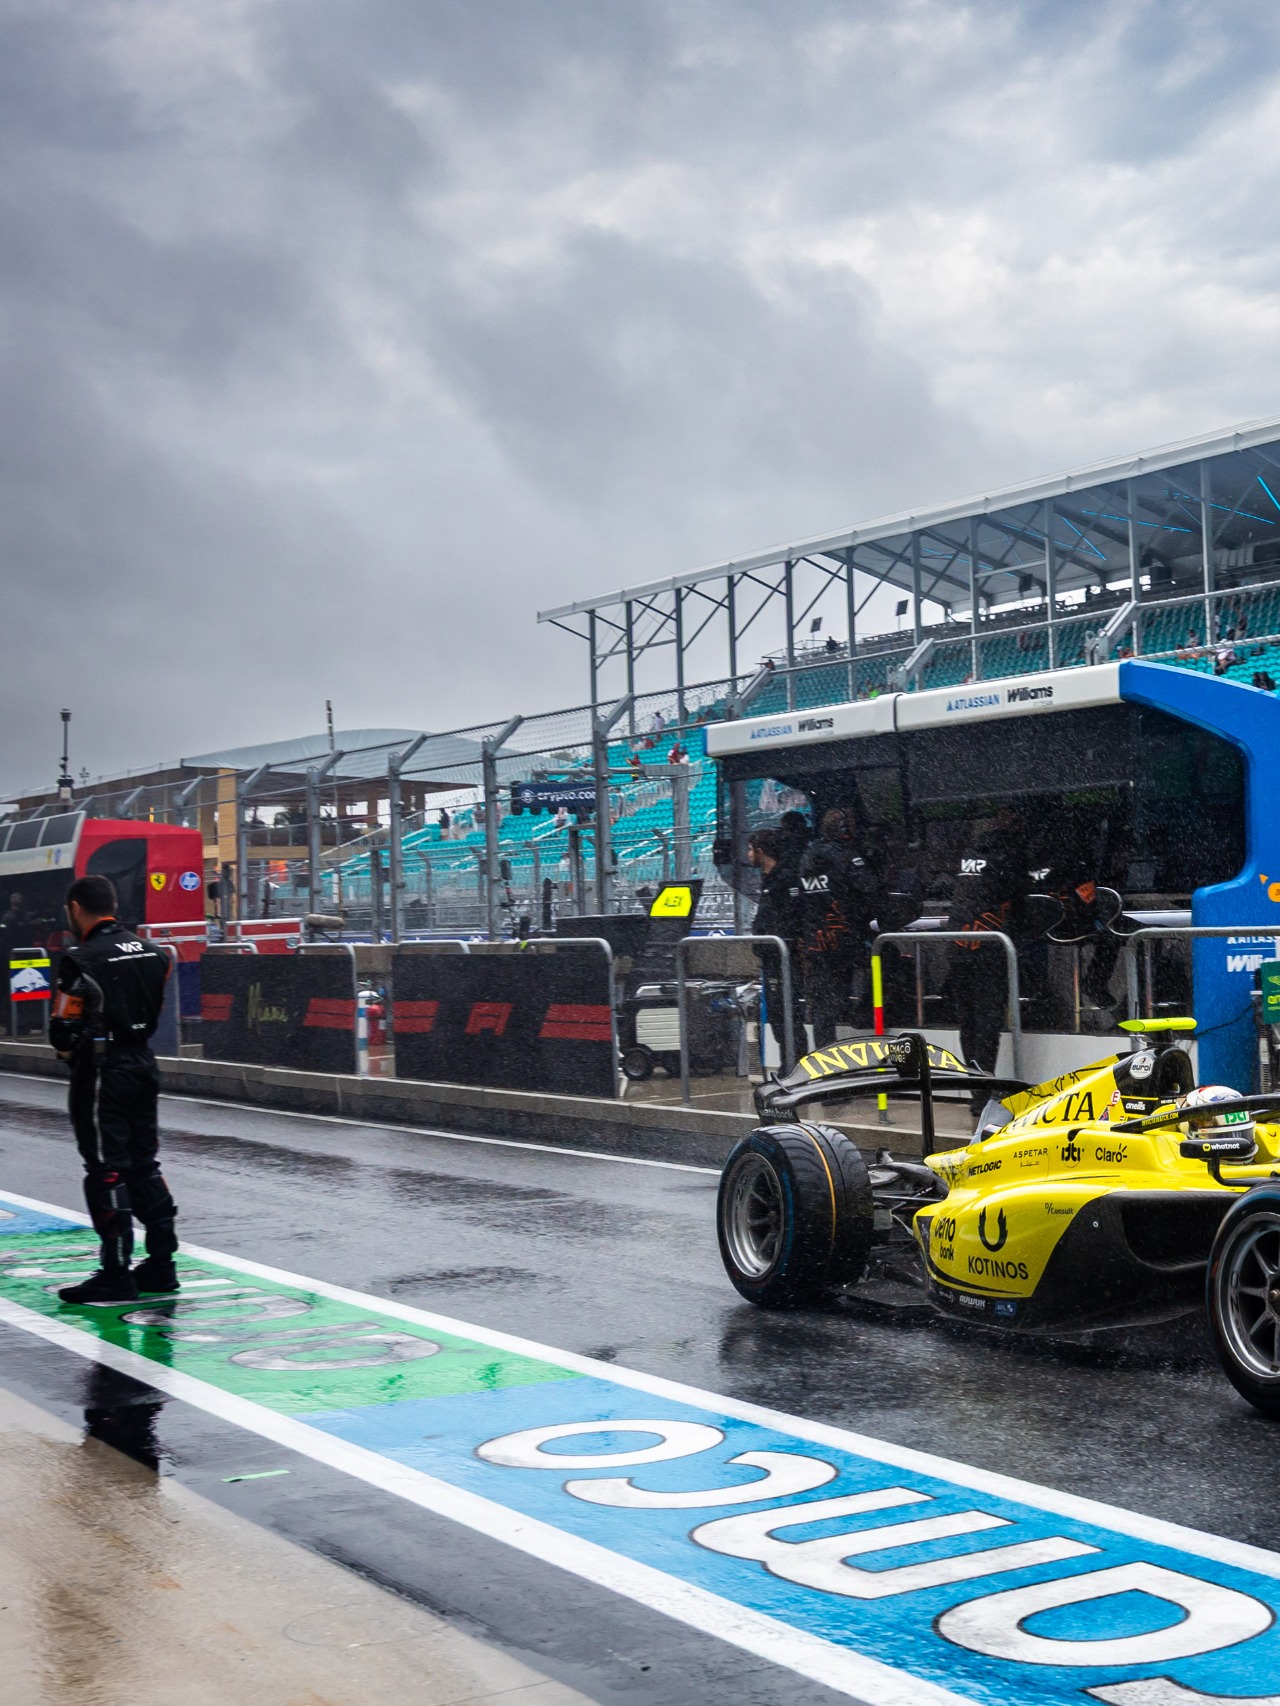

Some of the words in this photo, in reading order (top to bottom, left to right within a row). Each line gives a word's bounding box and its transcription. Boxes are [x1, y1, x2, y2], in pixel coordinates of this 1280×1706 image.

[1007, 686, 1054, 703] Williams
[115, 941, 145, 953] VAR
[799, 1041, 968, 1080] INVIA
[1112, 1091, 1120, 1103] E
[1013, 1147, 1049, 1159] ASPETAR
[1095, 1145, 1124, 1163] Claro
[1211, 1142, 1240, 1150] whatnot
[968, 1160, 1003, 1176] NETLOGIC
[939, 1244, 955, 1261] bank
[968, 1256, 1029, 1280] KOTINOS
